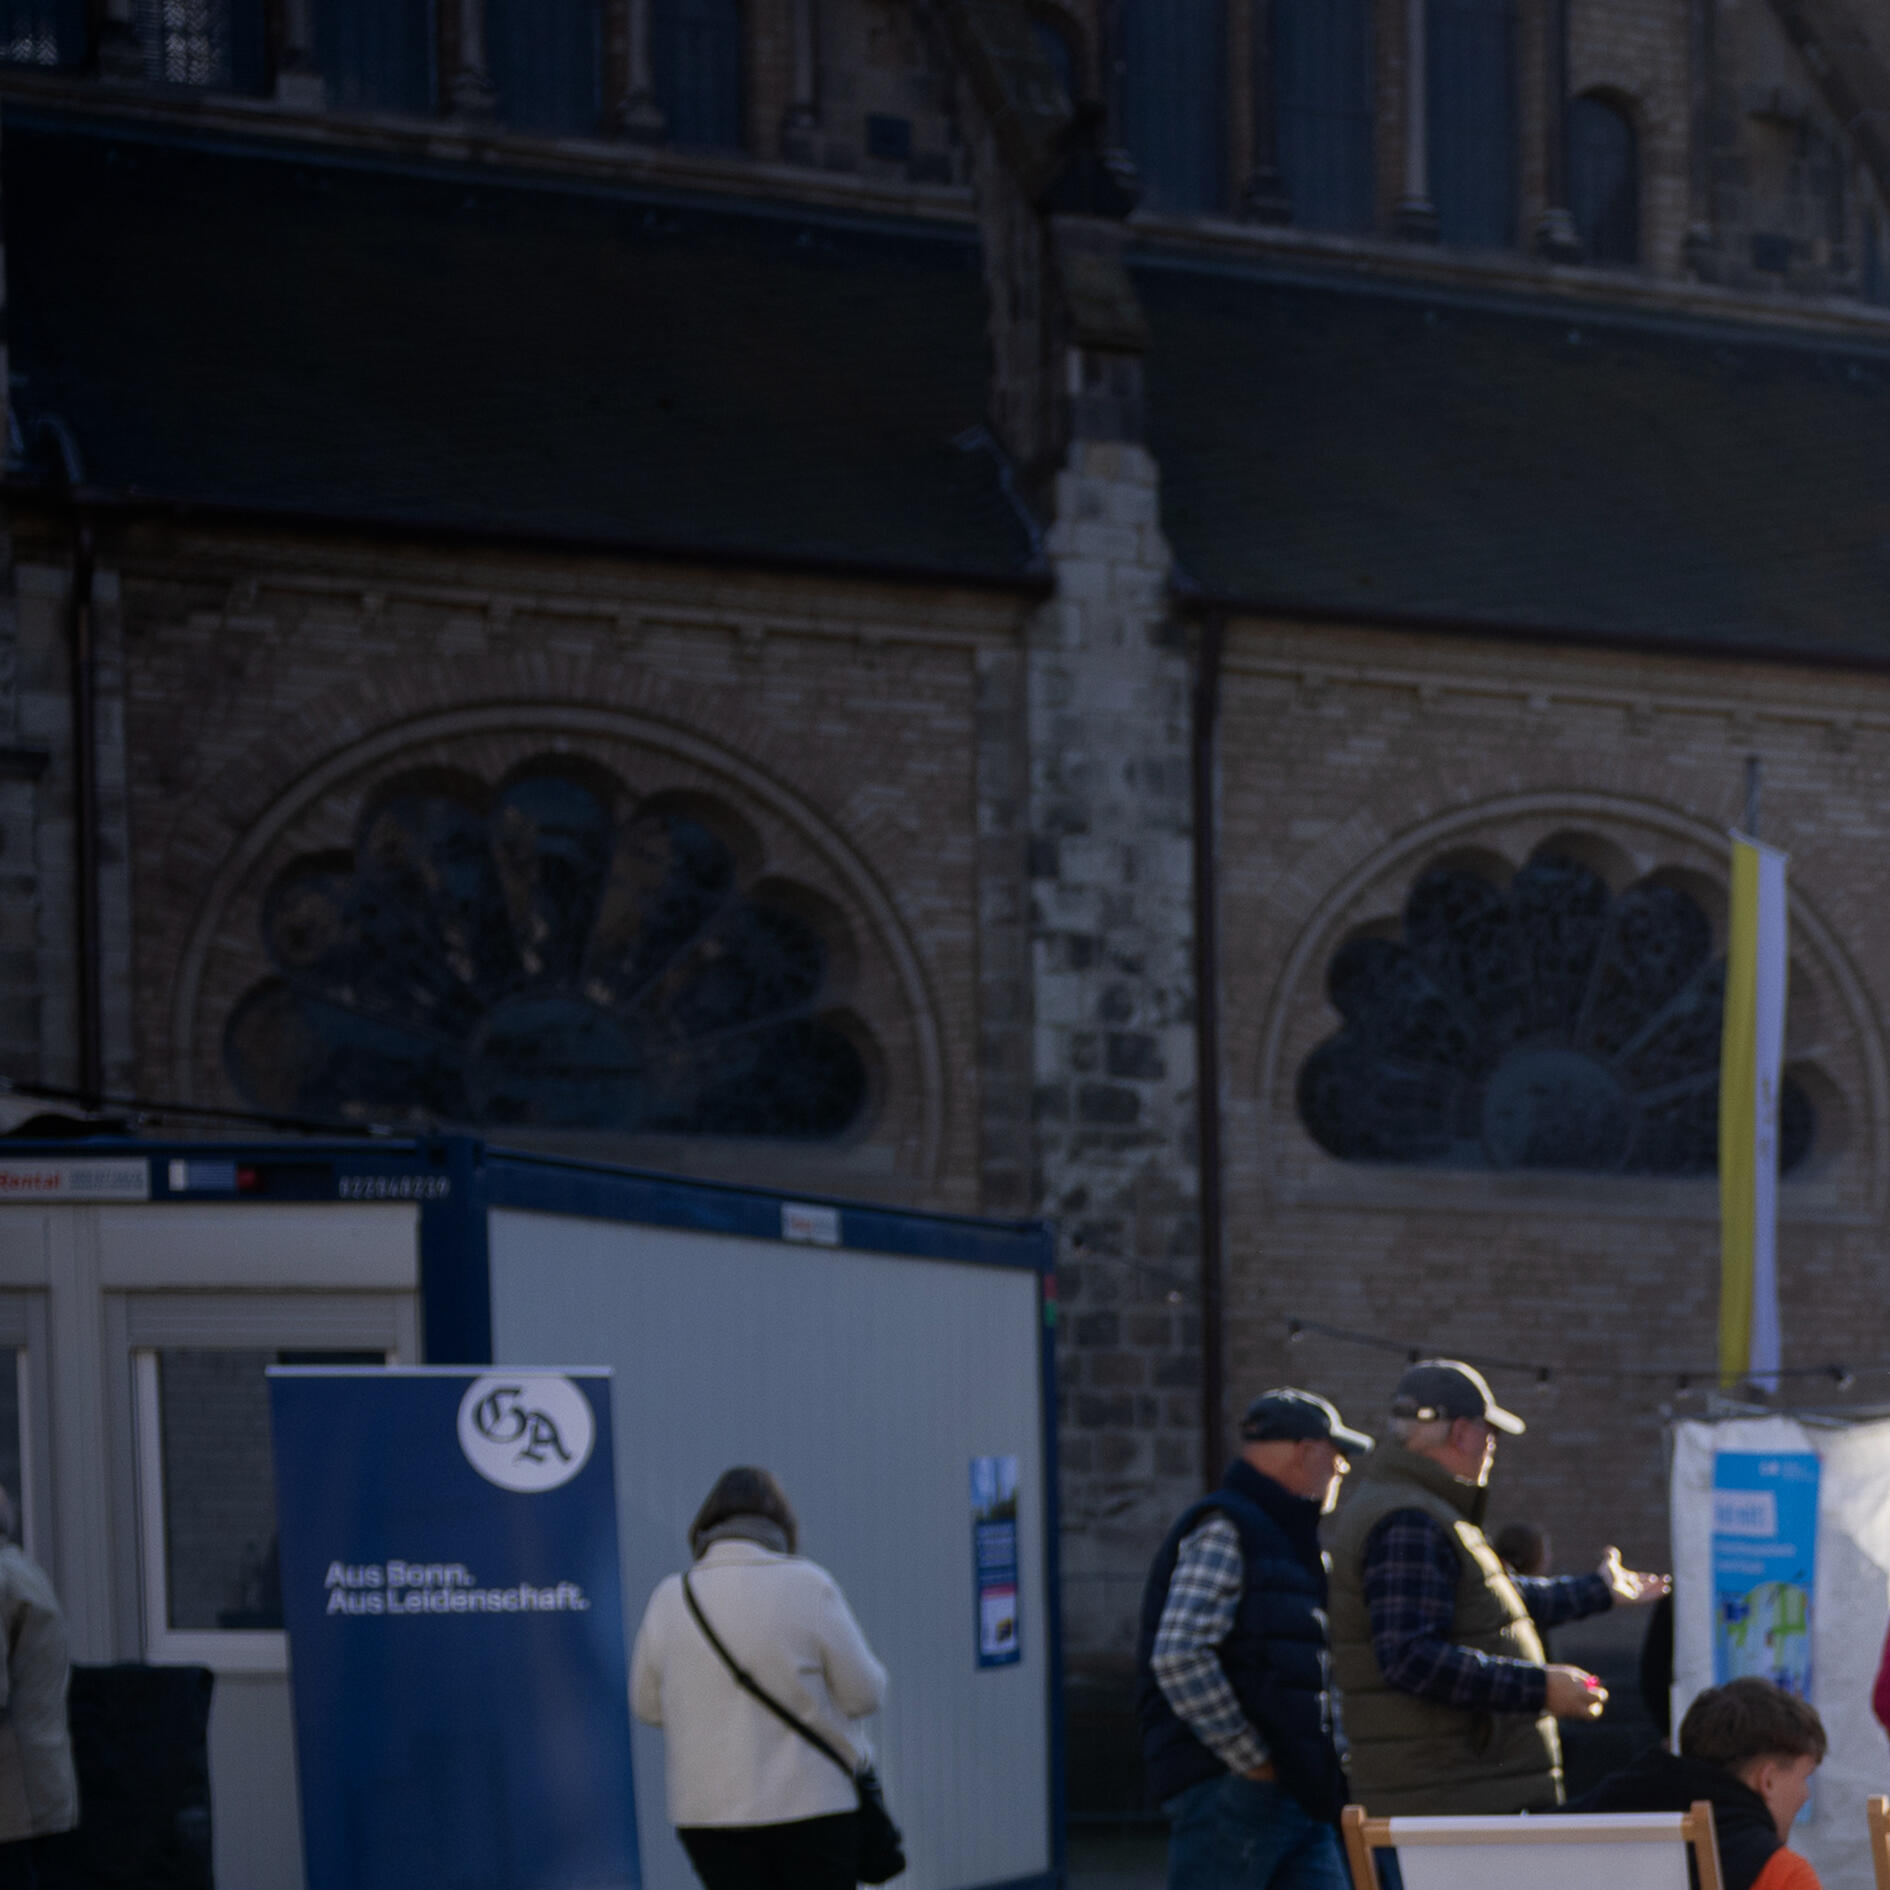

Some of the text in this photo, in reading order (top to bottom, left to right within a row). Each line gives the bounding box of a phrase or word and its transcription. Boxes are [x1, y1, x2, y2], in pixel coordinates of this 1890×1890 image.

[472, 1387, 571, 1464] GA
[324, 1560, 475, 1588] Aus Bonn.
[327, 1582, 591, 1614] Aus Leidenschaft.
